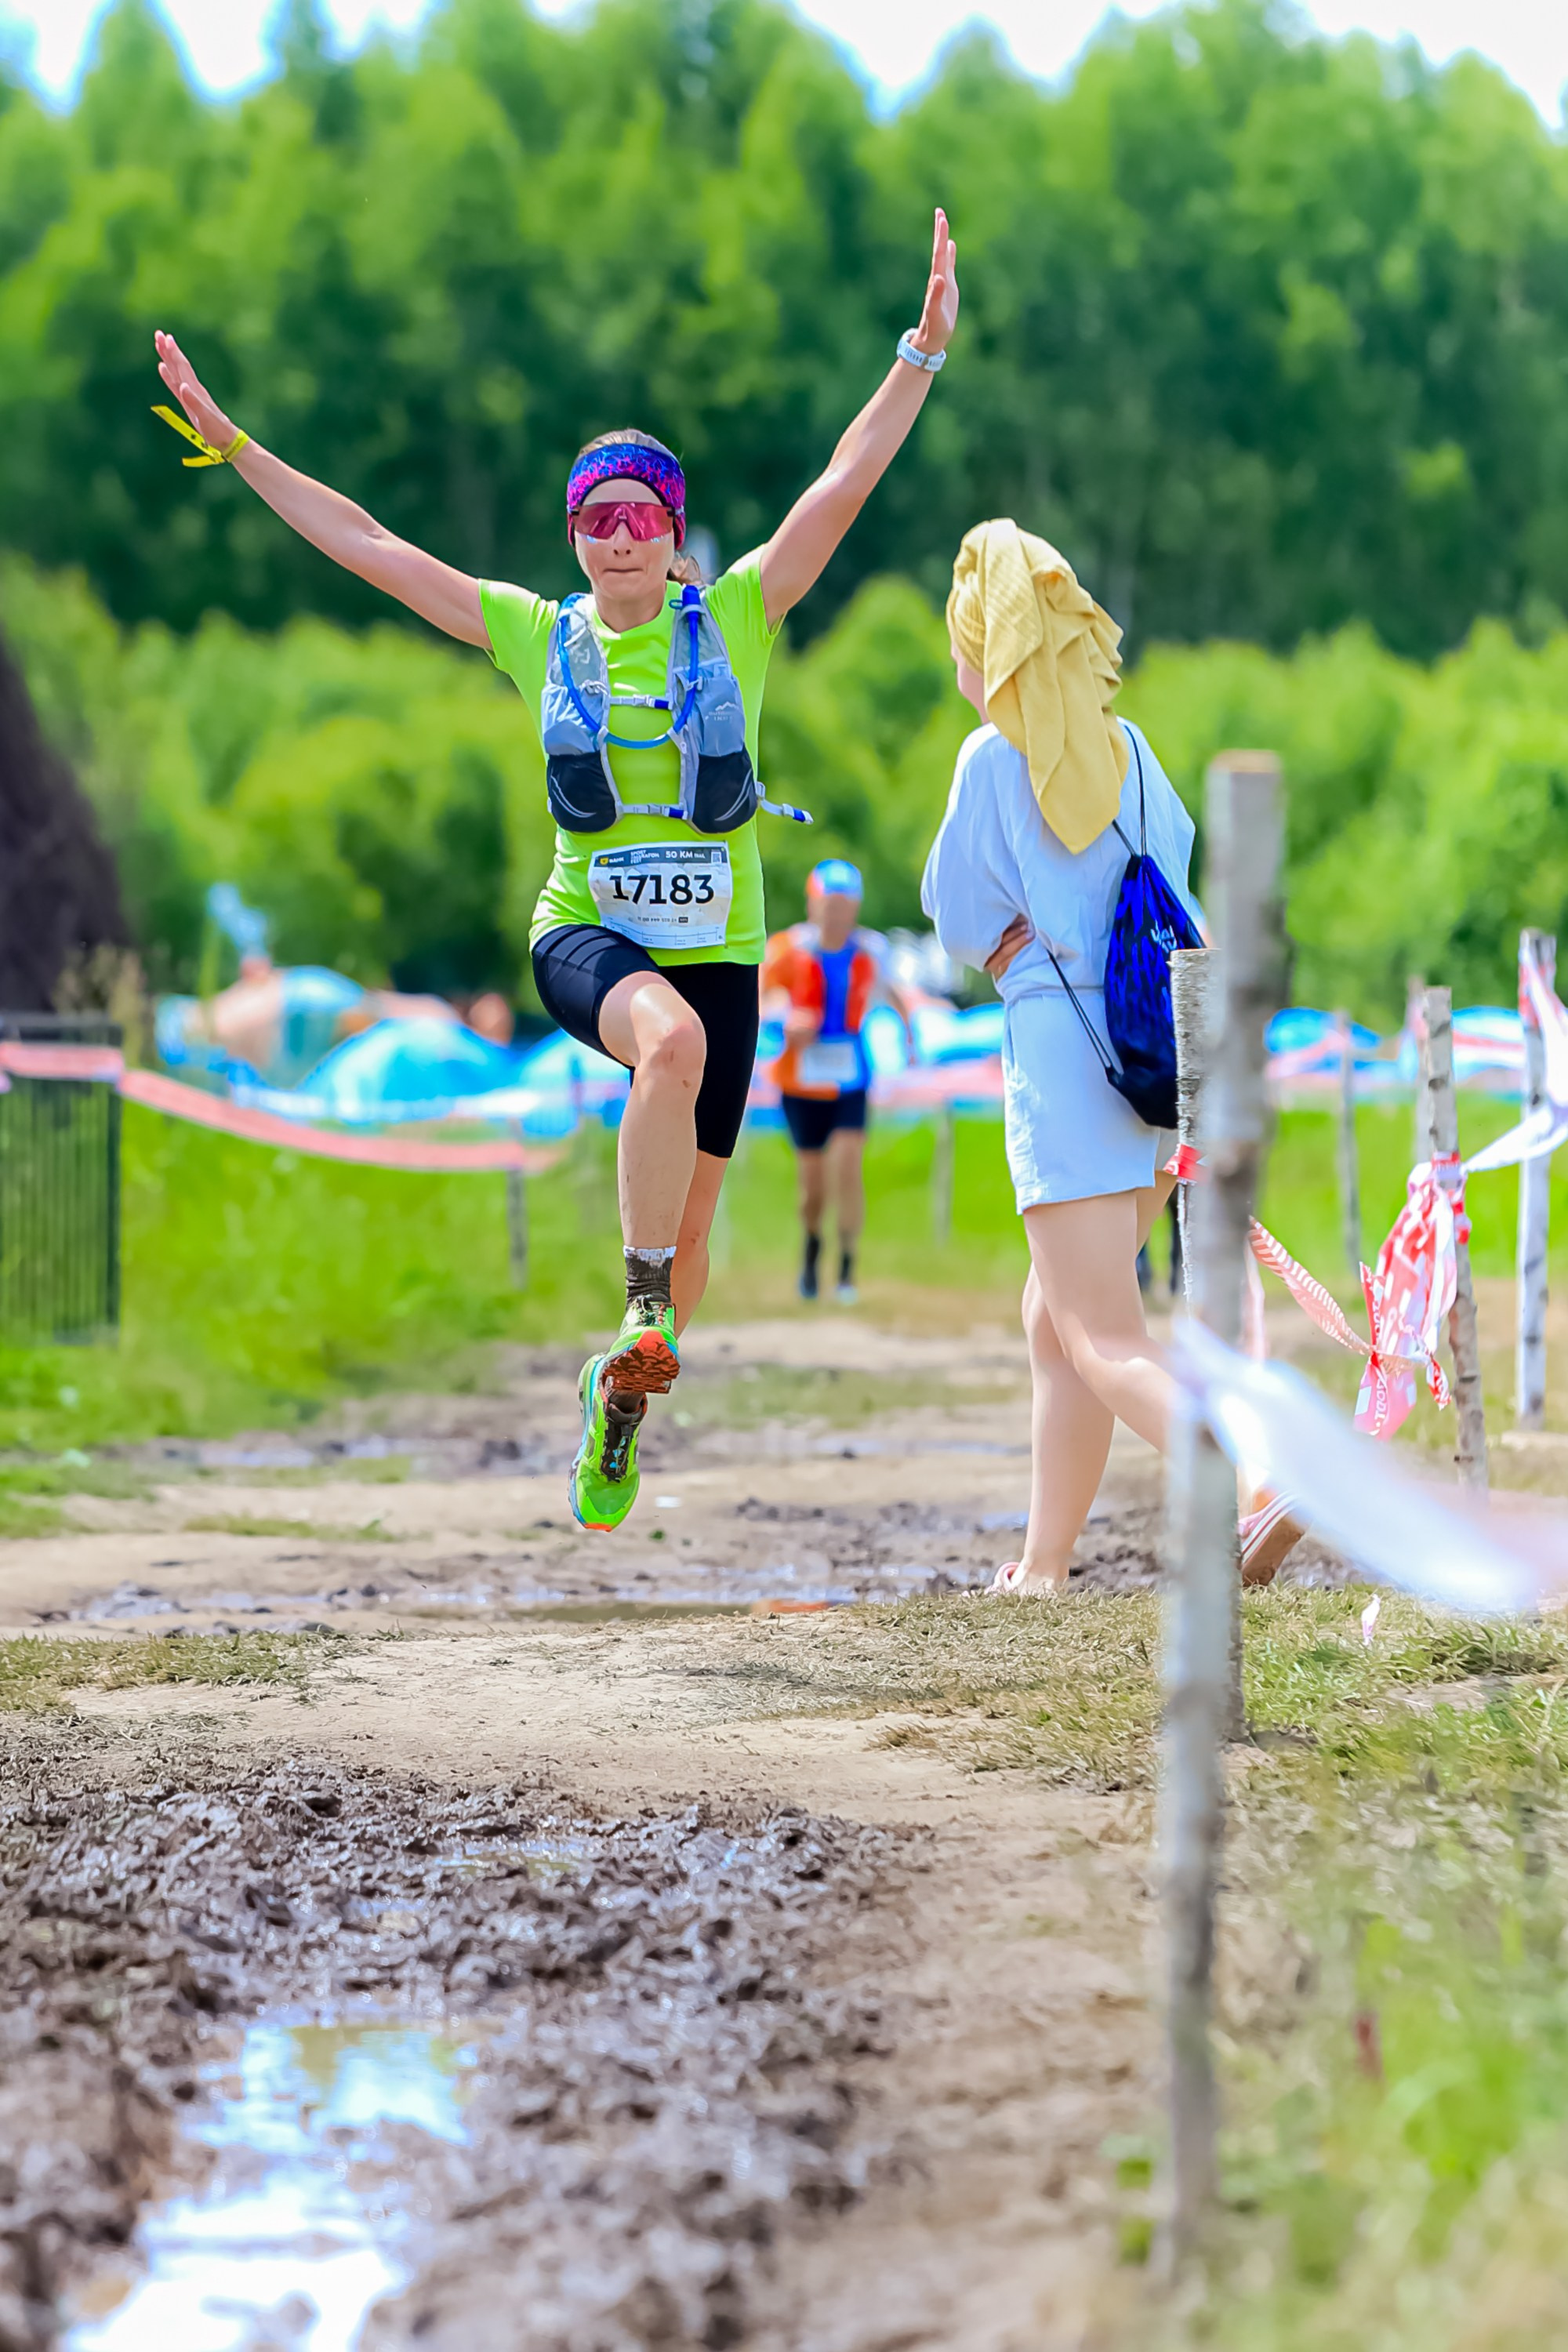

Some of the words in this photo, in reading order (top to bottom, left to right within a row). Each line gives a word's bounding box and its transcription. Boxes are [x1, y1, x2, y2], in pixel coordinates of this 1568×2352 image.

[665, 850, 677, 858] 50
[680, 850, 693, 858] KM
[609, 874, 714, 906] 17183
